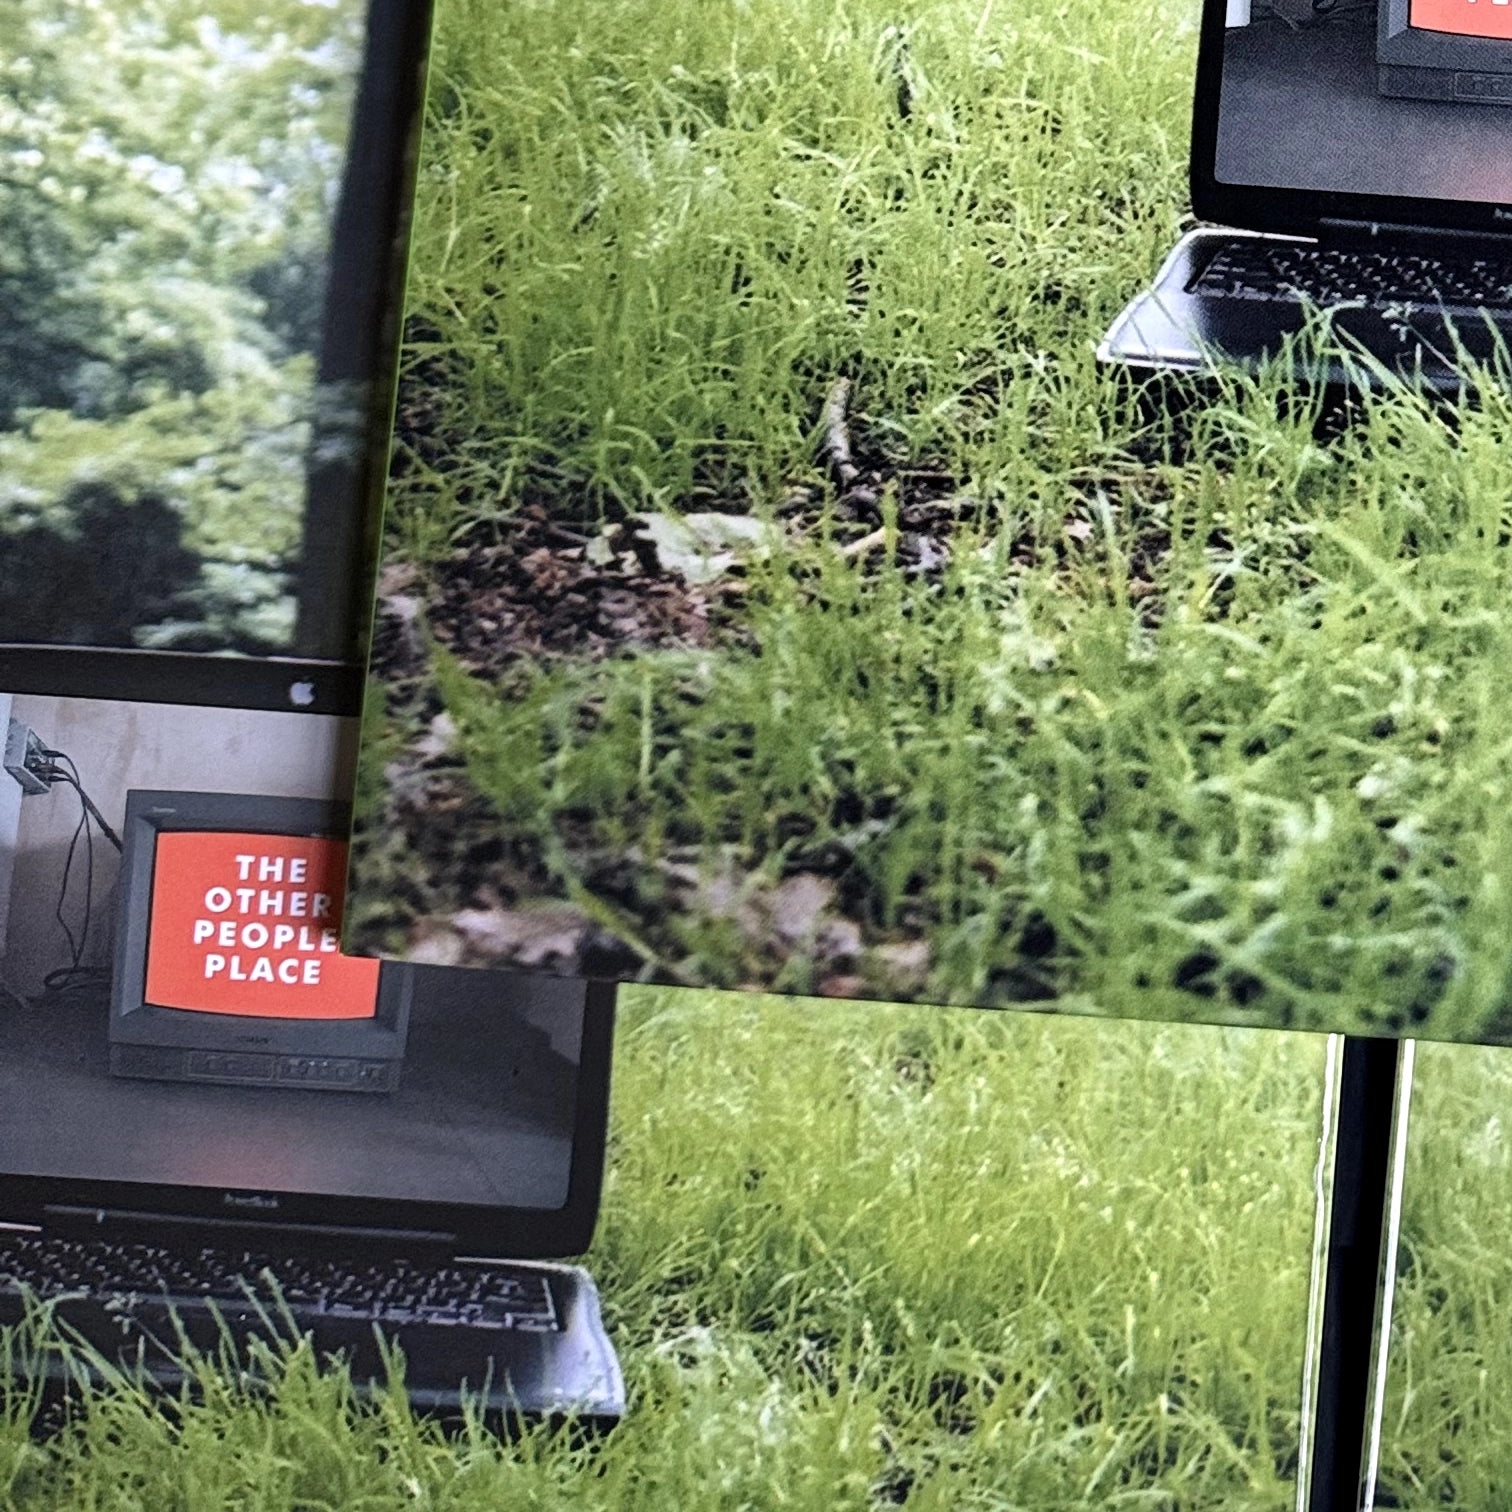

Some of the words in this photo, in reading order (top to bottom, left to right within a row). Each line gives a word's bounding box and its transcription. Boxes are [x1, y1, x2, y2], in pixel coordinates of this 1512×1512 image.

[234, 854, 307, 884] THE
[204, 886, 332, 918] OTHER
[193, 919, 338, 953] PEOPLE
[204, 953, 322, 985] PLACE
